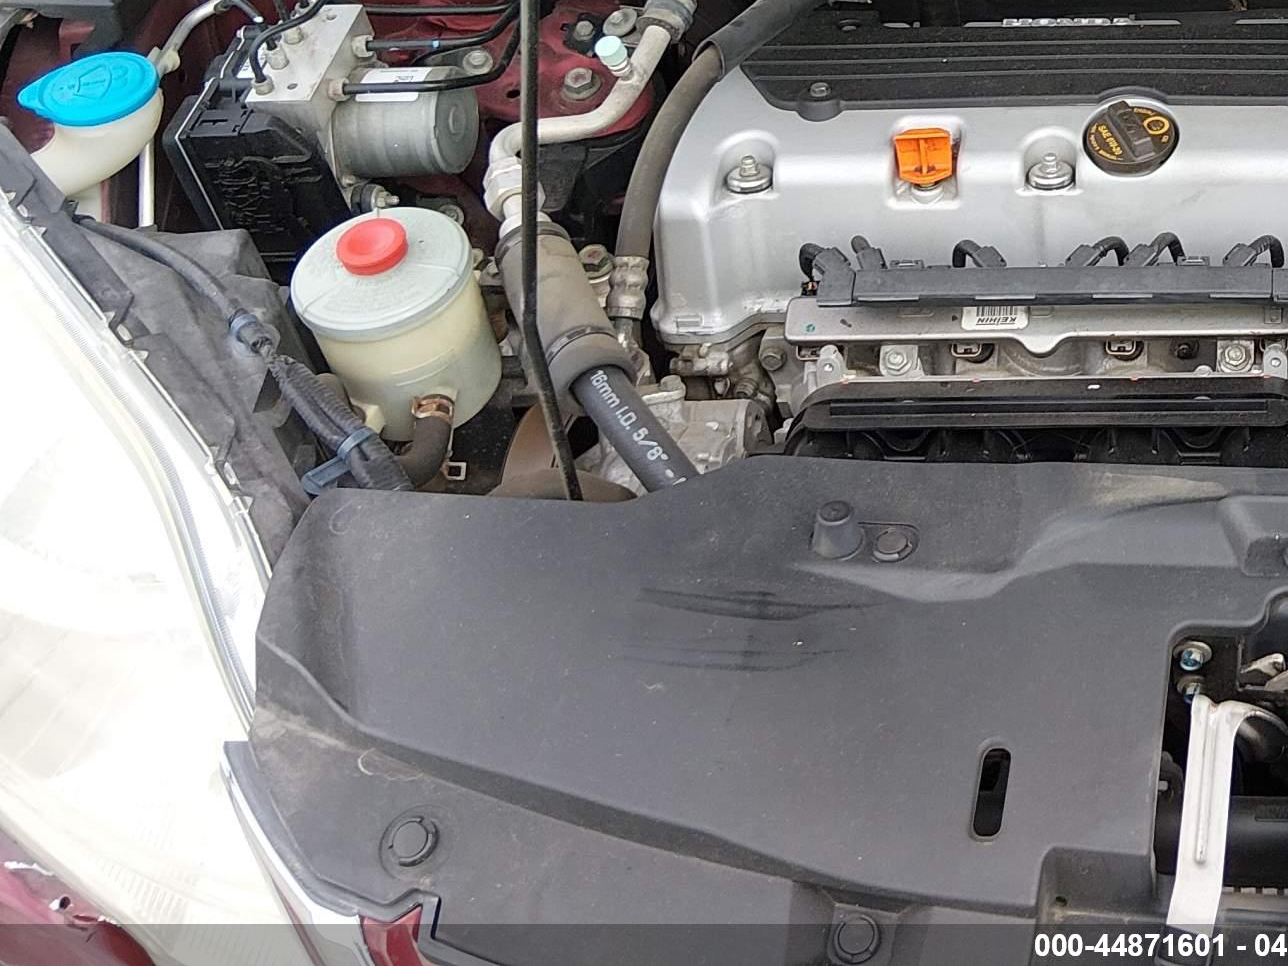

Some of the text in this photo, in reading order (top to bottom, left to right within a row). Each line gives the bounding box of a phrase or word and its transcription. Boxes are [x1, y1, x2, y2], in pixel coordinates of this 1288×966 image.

[1002, 18, 1135, 27] HONDA
[976, 316, 1017, 326] KEIHIN
[590, 370, 620, 408] 16mm
